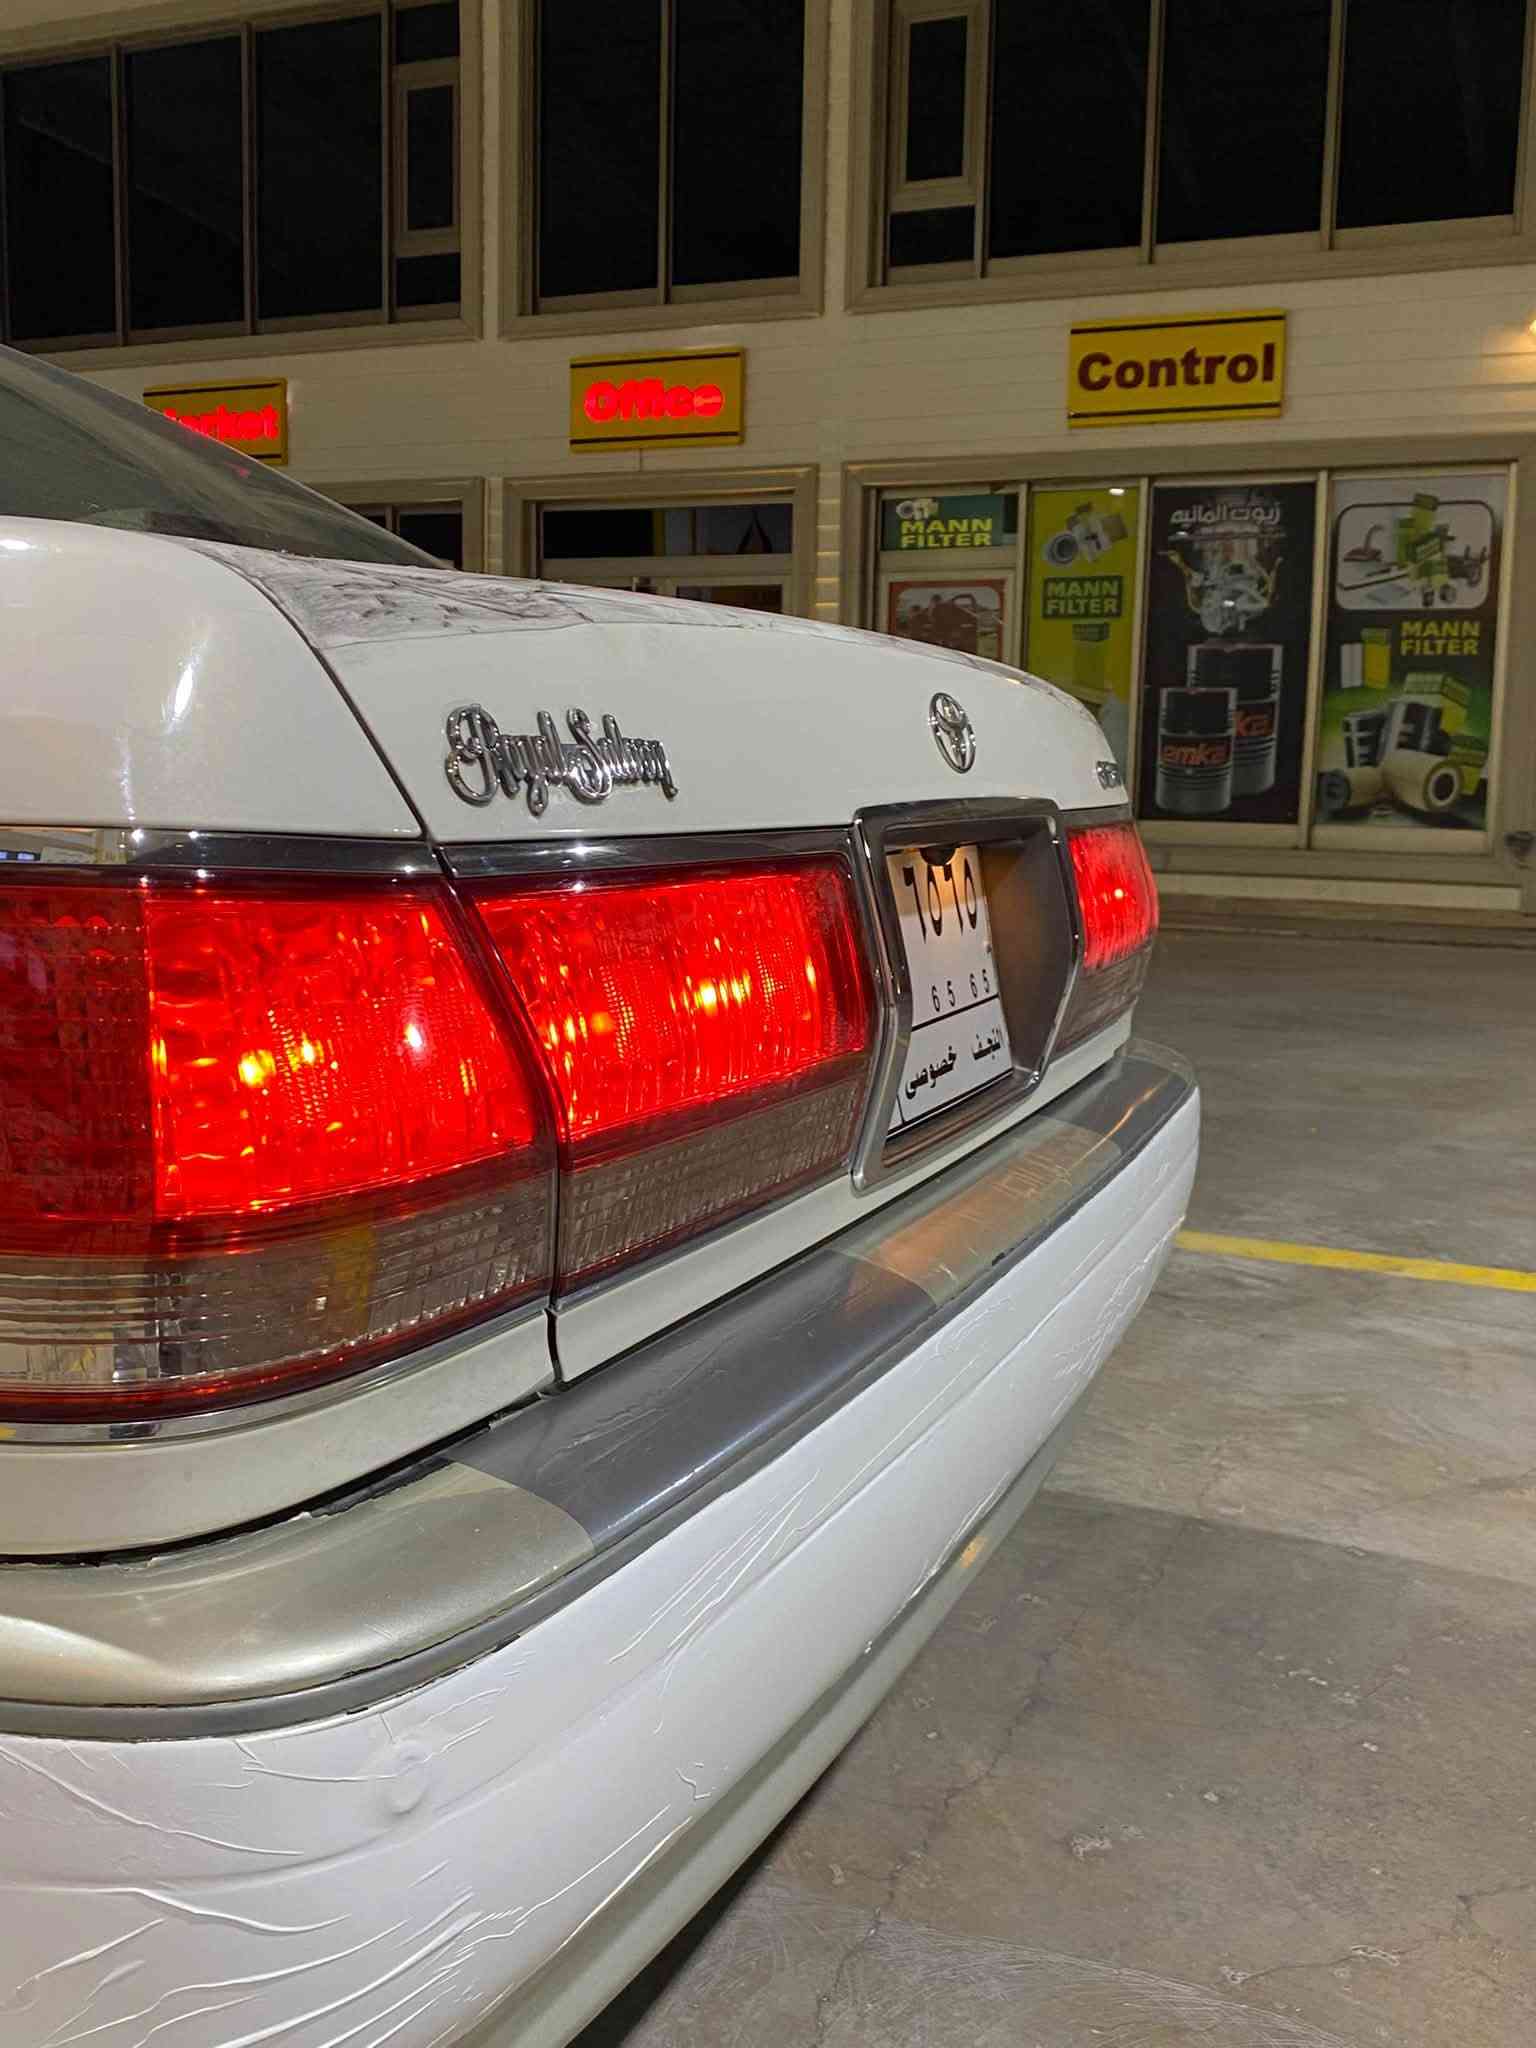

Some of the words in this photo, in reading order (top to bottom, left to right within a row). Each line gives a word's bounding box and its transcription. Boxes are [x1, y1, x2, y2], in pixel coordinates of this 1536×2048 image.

[1078, 343, 1275, 391] Control
[584, 377, 724, 423] Office
[163, 404, 279, 442] arket
[901, 519, 992, 534] MANN
[900, 532, 992, 548] FILTER
[1046, 580, 1119, 598] MANN
[1046, 598, 1118, 615] FILTER
[1401, 621, 1480, 637] MANN
[1400, 639, 1478, 656] FILTER
